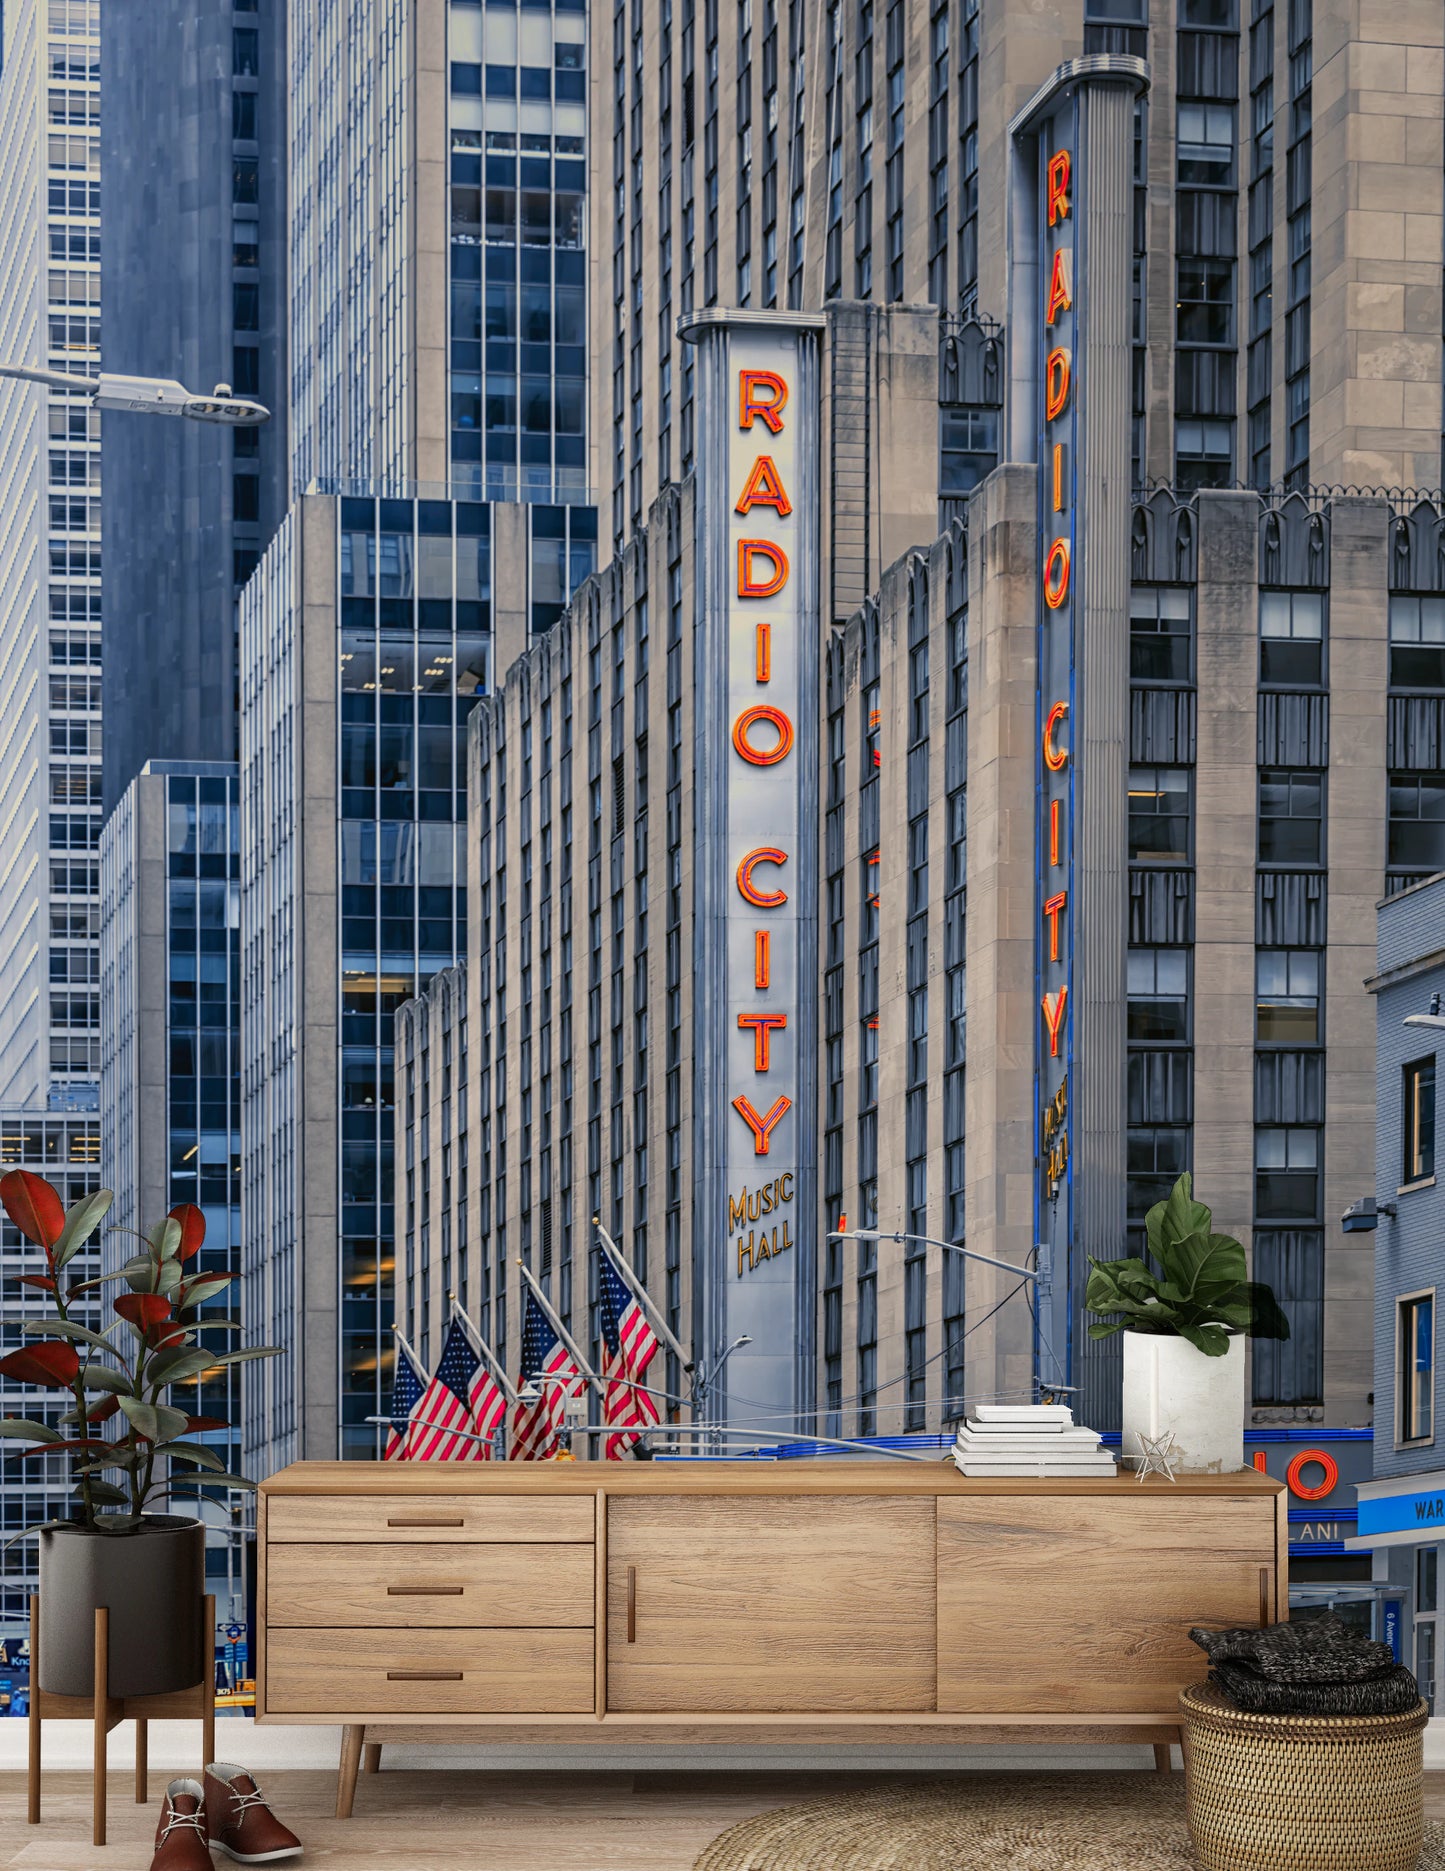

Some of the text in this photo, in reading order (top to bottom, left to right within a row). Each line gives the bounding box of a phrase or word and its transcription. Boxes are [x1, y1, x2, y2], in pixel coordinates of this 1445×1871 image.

[1042, 149, 1071, 1057] RADIO CITY
[732, 369, 794, 1155] RADIO CITY
[729, 1172, 794, 1237] MUSIC
[738, 1219, 794, 1279] HALL
[1288, 1522, 1338, 1540] ANI
[1414, 1498, 1444, 1521] WAR
